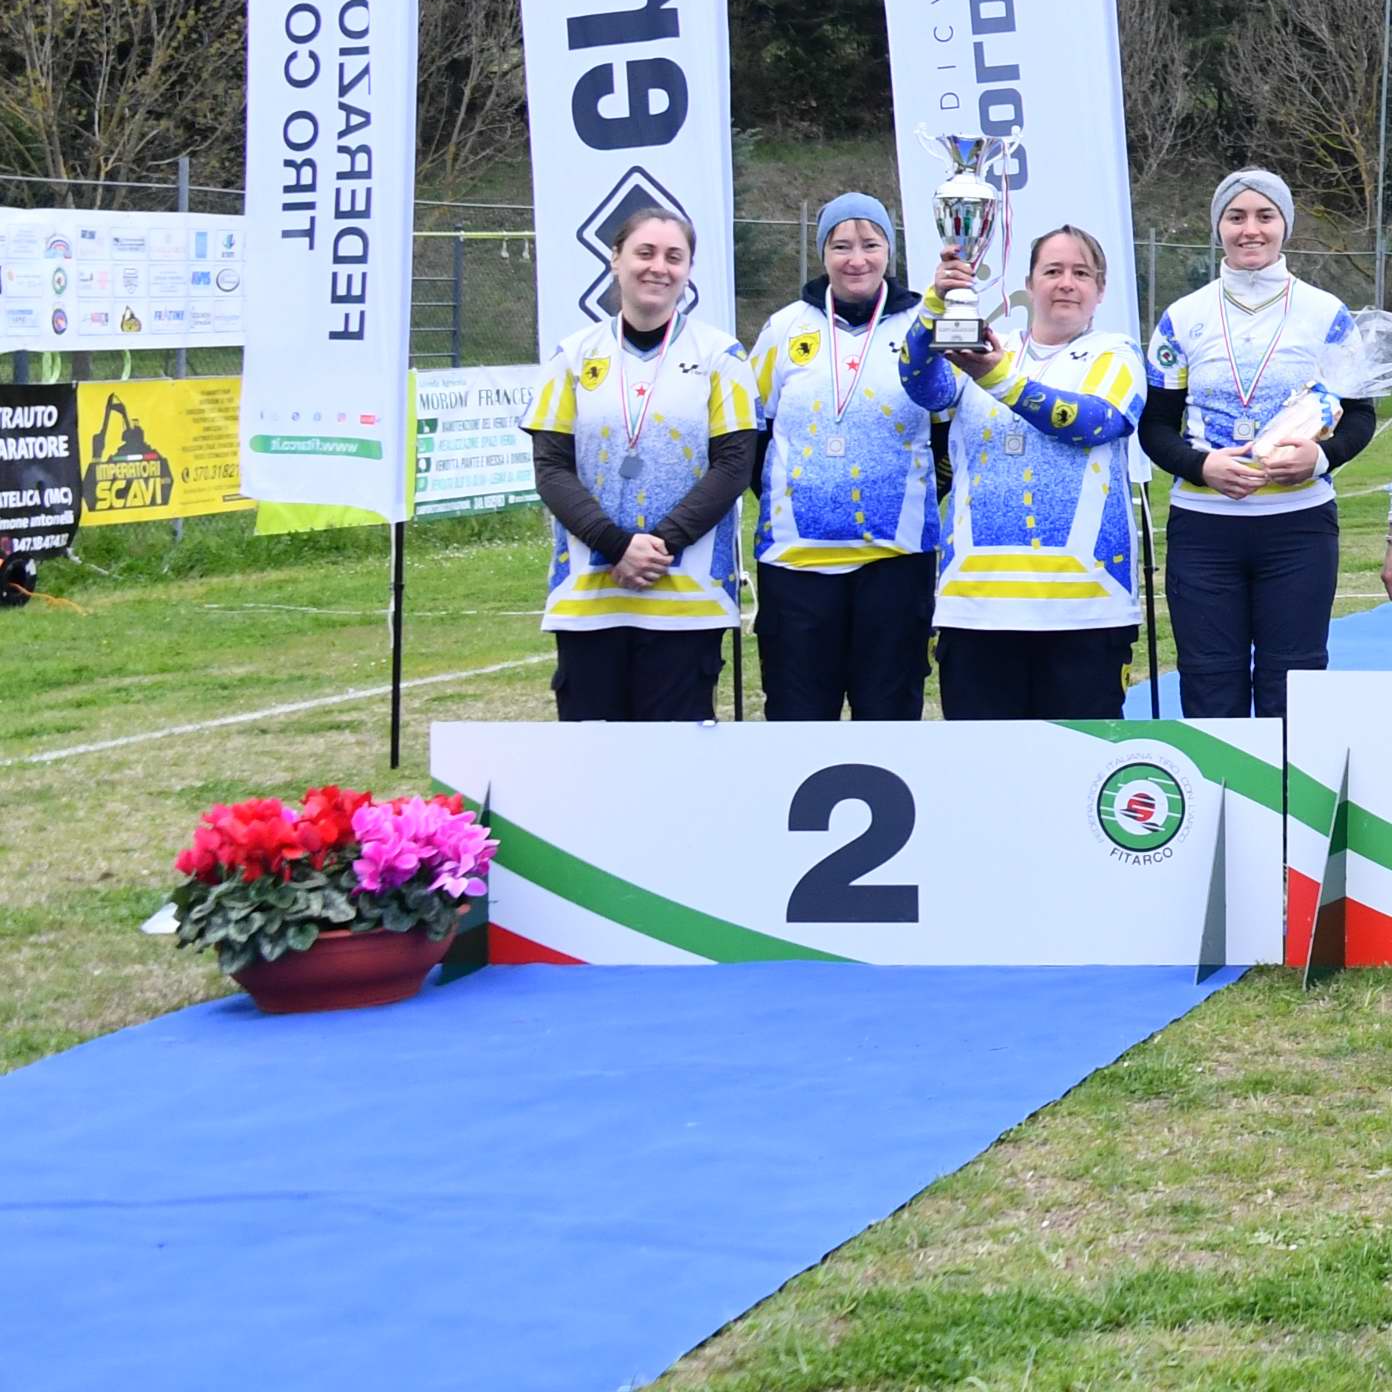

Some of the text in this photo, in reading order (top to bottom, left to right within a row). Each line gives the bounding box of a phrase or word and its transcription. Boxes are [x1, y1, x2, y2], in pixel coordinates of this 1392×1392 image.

[479, 387, 534, 407] FRANCES
[0, 405, 59, 430] RAUTO
[0, 435, 70, 460] ARATORE
[95, 461, 161, 481] IMPERATORI
[44, 487, 72, 506] (MC)
[95, 478, 163, 510] SCAVI
[786, 763, 919, 923] 2
[1110, 847, 1173, 866] FITARCO
